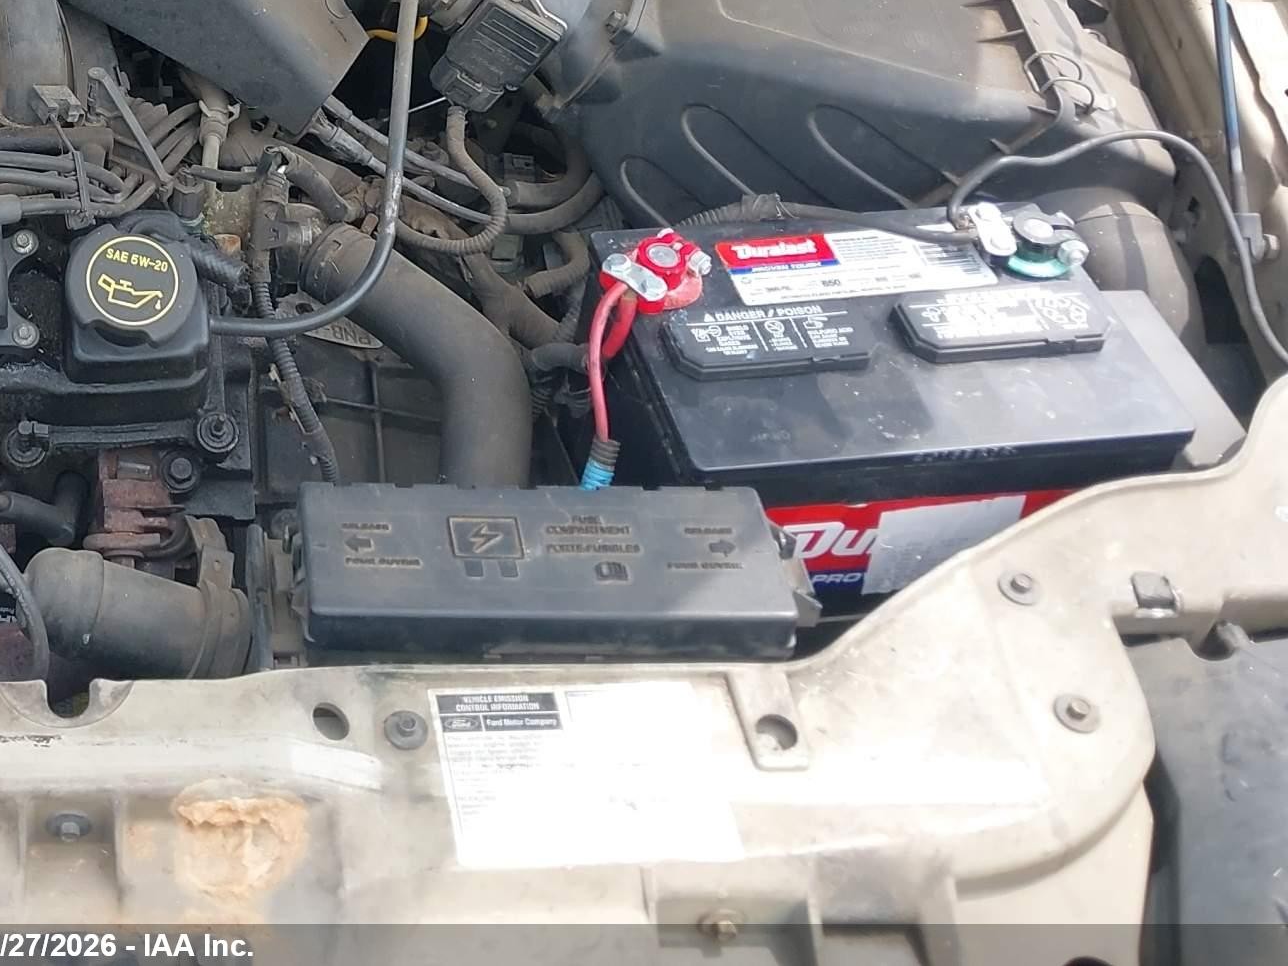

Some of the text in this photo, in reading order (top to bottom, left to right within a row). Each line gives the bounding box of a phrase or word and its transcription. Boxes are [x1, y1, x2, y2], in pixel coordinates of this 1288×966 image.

[730, 238, 817, 259] Duralast
[105, 248, 129, 263] SAE
[715, 308, 766, 321] DANGER
[776, 305, 823, 316] POISON
[546, 524, 631, 535] COMPARTMENT
[783, 522, 878, 559] Du
[462, 694, 529, 703] VEHICLE EMISSION
[455, 702, 540, 712] CONTROL INFORMATION
[503, 718, 524, 726] Motor
[524, 717, 557, 727] Company
